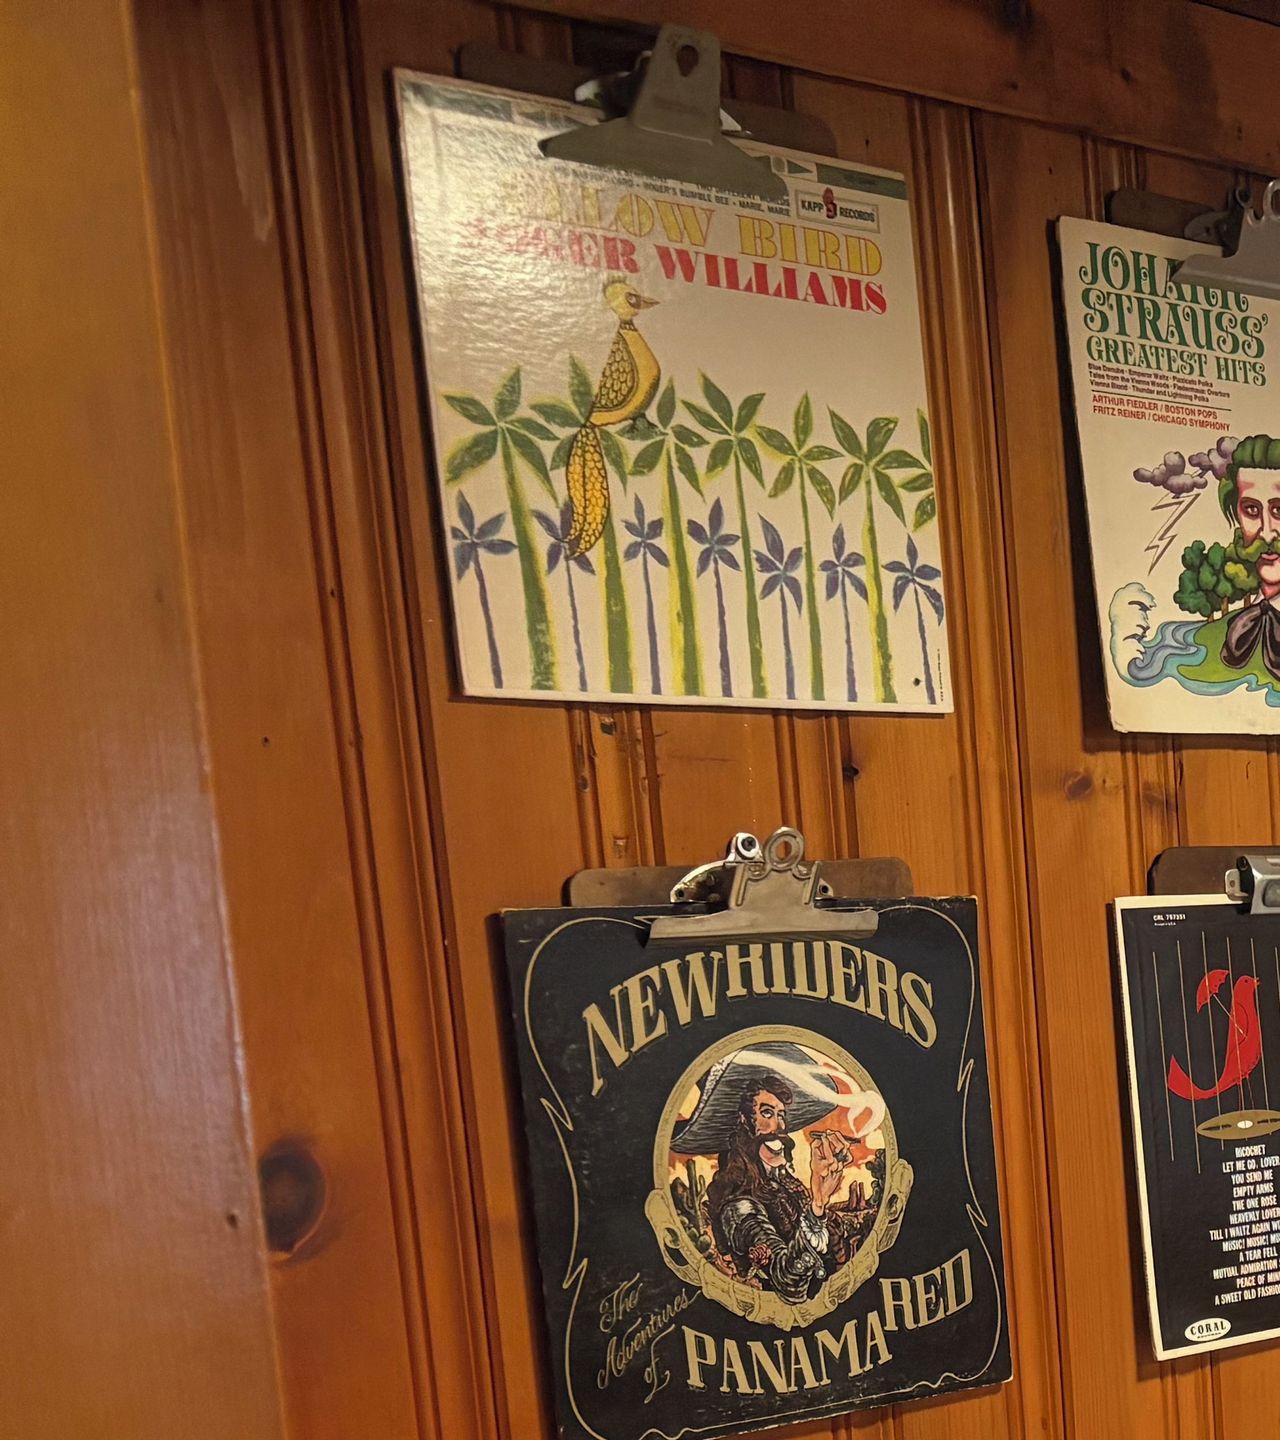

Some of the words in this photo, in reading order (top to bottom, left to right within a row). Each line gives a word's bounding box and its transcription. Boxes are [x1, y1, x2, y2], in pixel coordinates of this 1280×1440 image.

[801, 200, 824, 213] KAPP
[839, 207, 875, 222] RECORDS
[497, 168, 716, 247] LLOW
[736, 214, 883, 276] BIRD
[457, 215, 641, 274] GER
[654, 244, 887, 315] WILLIAMS
[1081, 287, 1269, 359] STRAUSS'
[1087, 335, 1208, 378] GREATEST
[1215, 356, 1267, 387] HITS
[1089, 371, 1105, 380] Tales
[1106, 373, 1120, 382] from
[1120, 375, 1131, 383] the
[1131, 377, 1150, 387] Vienna
[1151, 380, 1170, 390] Woods
[1090, 379, 1110, 388] Vienna
[1132, 385, 1155, 395] Thunder
[1156, 388, 1167, 397] and
[1194, 393, 1210, 403] Polka
[1092, 394, 1125, 406] ARTHUR
[1126, 399, 1159, 411] FIEDLER
[1164, 404, 1197, 417] BOSTON
[1197, 409, 1218, 420] POPS
[1093, 405, 1116, 417] FRITZ
[1117, 408, 1147, 421] REINER
[1152, 413, 1188, 427] CHICAGO
[1189, 418, 1231, 432] SYMPHONY
[582, 951, 723, 1098] NEW
[725, 940, 939, 1050] RIDERS
[1235, 1144, 1266, 1158] RICOCHET
[1222, 1162, 1234, 1173] LET
[1236, 1160, 1246, 1171] ME
[1260, 1155, 1280, 1168] LOVER
[1231, 1173, 1244, 1185] YOU
[1246, 1171, 1262, 1183] SEND
[1263, 1169, 1273, 1180] ME
[1233, 1185, 1255, 1198] EMPTY
[1256, 1182, 1274, 1195] ARMS
[1232, 1200, 1244, 1211] THE
[1246, 1197, 1260, 1209] ONE
[1260, 1195, 1277, 1207] ROSE
[1229, 1210, 1260, 1225] HEAVENLY
[1261, 1207, 1280, 1220] LOVER
[1209, 1229, 1224, 1241] TILL
[1229, 1225, 1250, 1238] WALTZ
[1251, 1221, 1271, 1234] AGAIN
[1222, 1238, 1246, 1252] MUSIC!
[1246, 1235, 1269, 1248] MUSIC!
[1239, 1251, 1245, 1263] A
[1245, 1249, 1262, 1261] TEAR
[1262, 1246, 1278, 1258] FELL
[1213, 1266, 1239, 1280] MUTUAL
[1240, 1259, 1278, 1275] ADMIRATION
[1236, 1275, 1256, 1289] PEACE
[1257, 1274, 1266, 1285] OF
[1214, 1295, 1220, 1306] A
[1221, 1291, 1242, 1305] SWEET
[1243, 1288, 1257, 1300] OLD
[682, 1312, 893, 1395] PANAMA
[878, 1248, 974, 1331] RED
[1190, 1320, 1226, 1336] CORAL
[597, 1289, 702, 1391] Adventures
[644, 1324, 676, 1404] of
